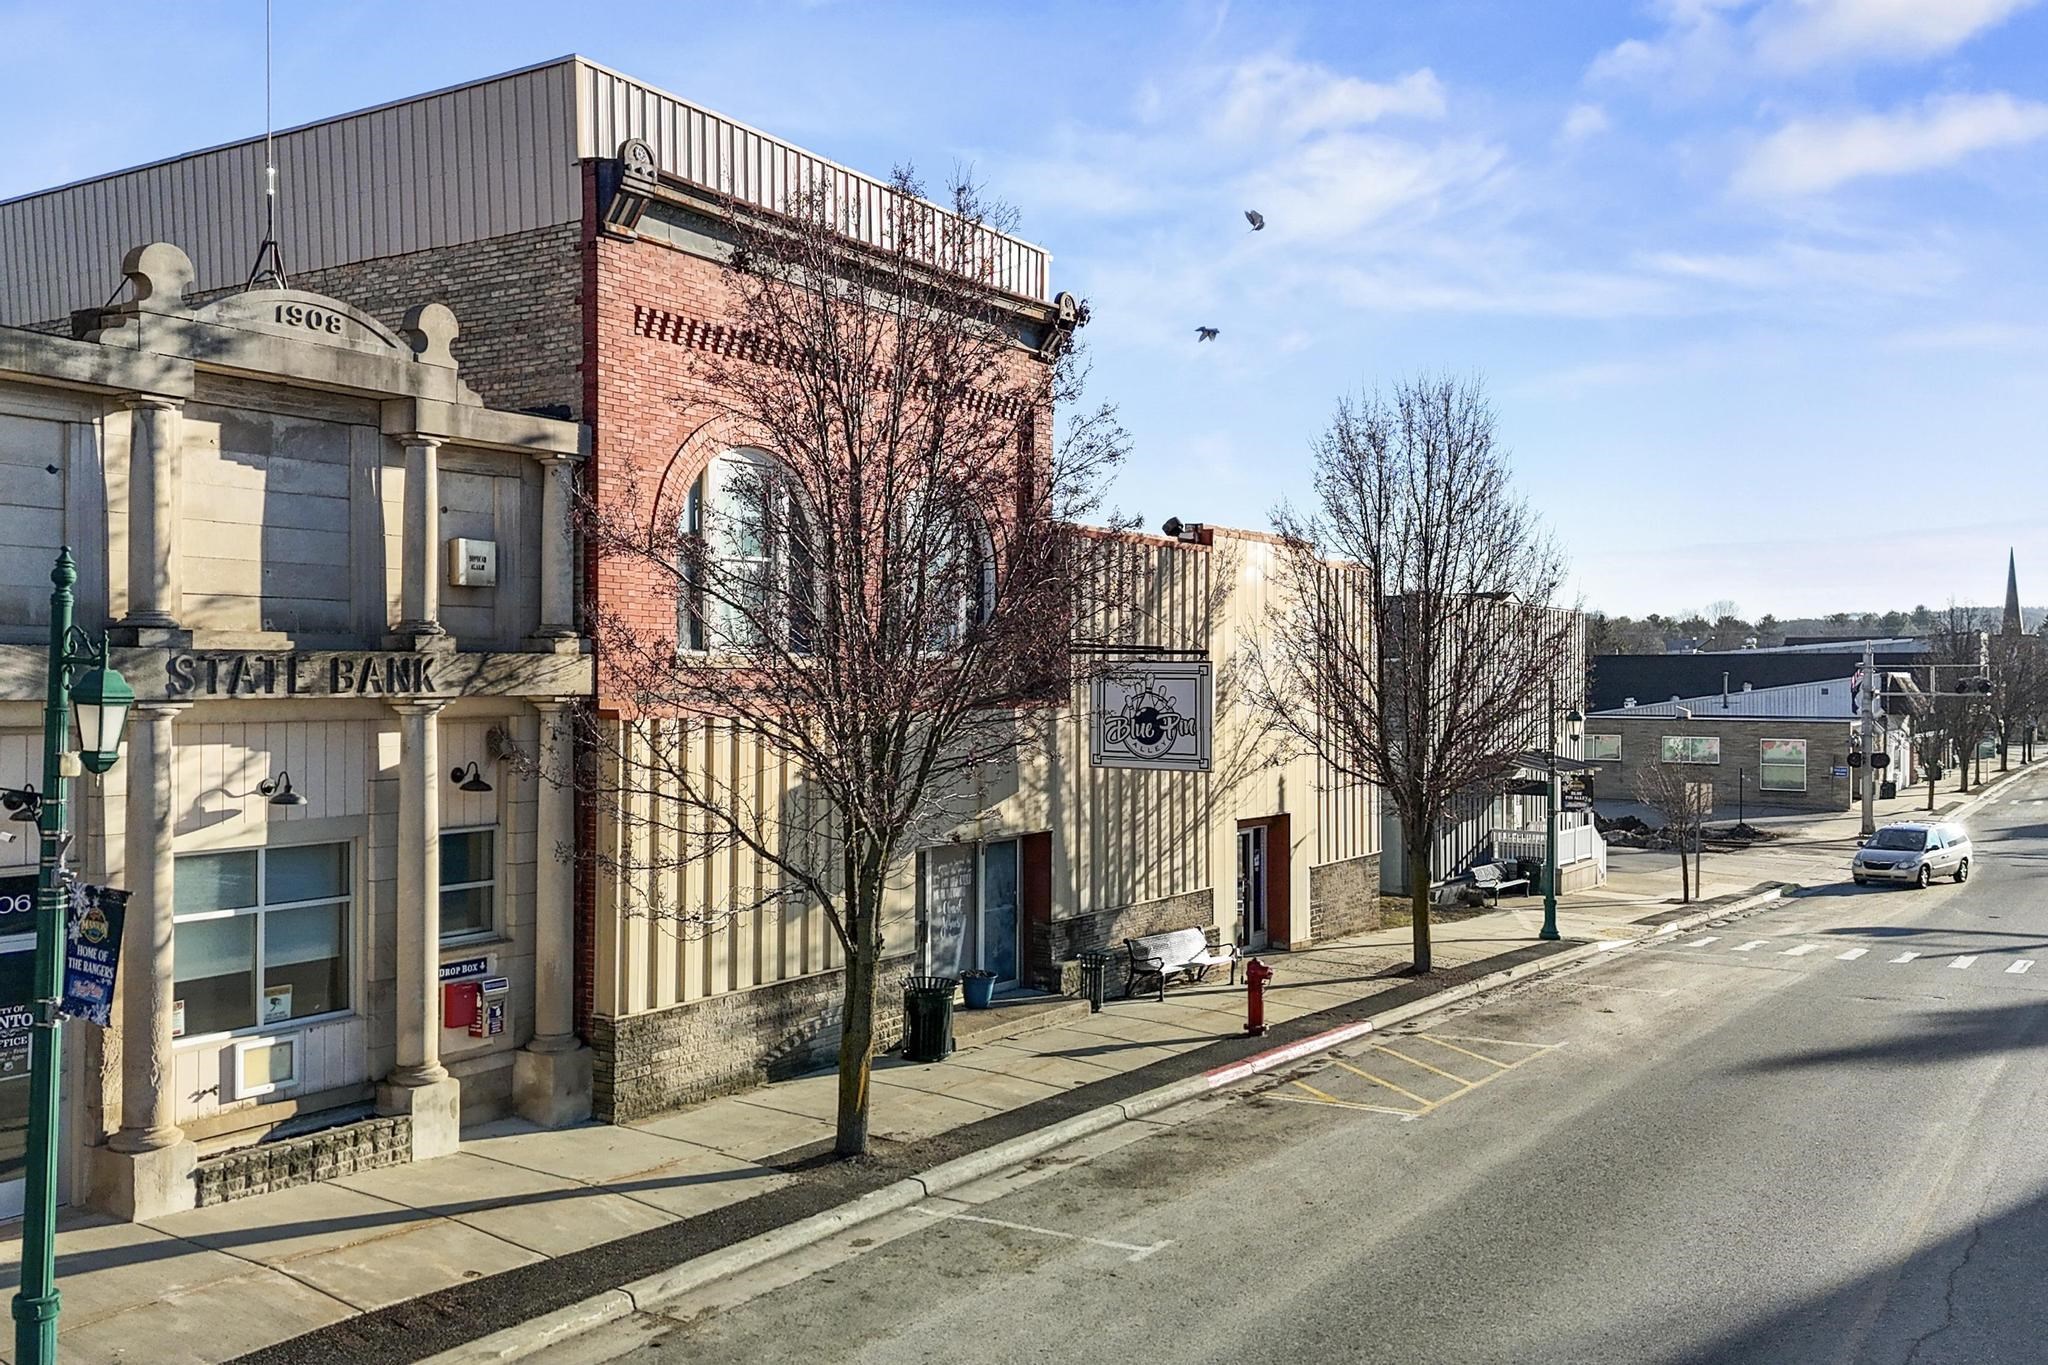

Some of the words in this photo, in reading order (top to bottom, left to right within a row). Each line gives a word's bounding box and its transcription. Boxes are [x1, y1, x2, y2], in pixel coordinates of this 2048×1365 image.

[275, 304, 341, 334] 1908
[165, 655, 312, 695] STATE
[329, 656, 437, 695] BANK
[1104, 716, 1156, 744] Blue
[1156, 711, 1197, 741] Pin
[1132, 741, 1167, 754] ALLEY
[77, 944, 98, 960] HOME
[98, 949, 109, 962] OF
[68, 957, 82, 972] THE
[83, 960, 115, 979] RANGERS
[439, 966, 461, 977] DROP
[461, 963, 478, 974] BOX
